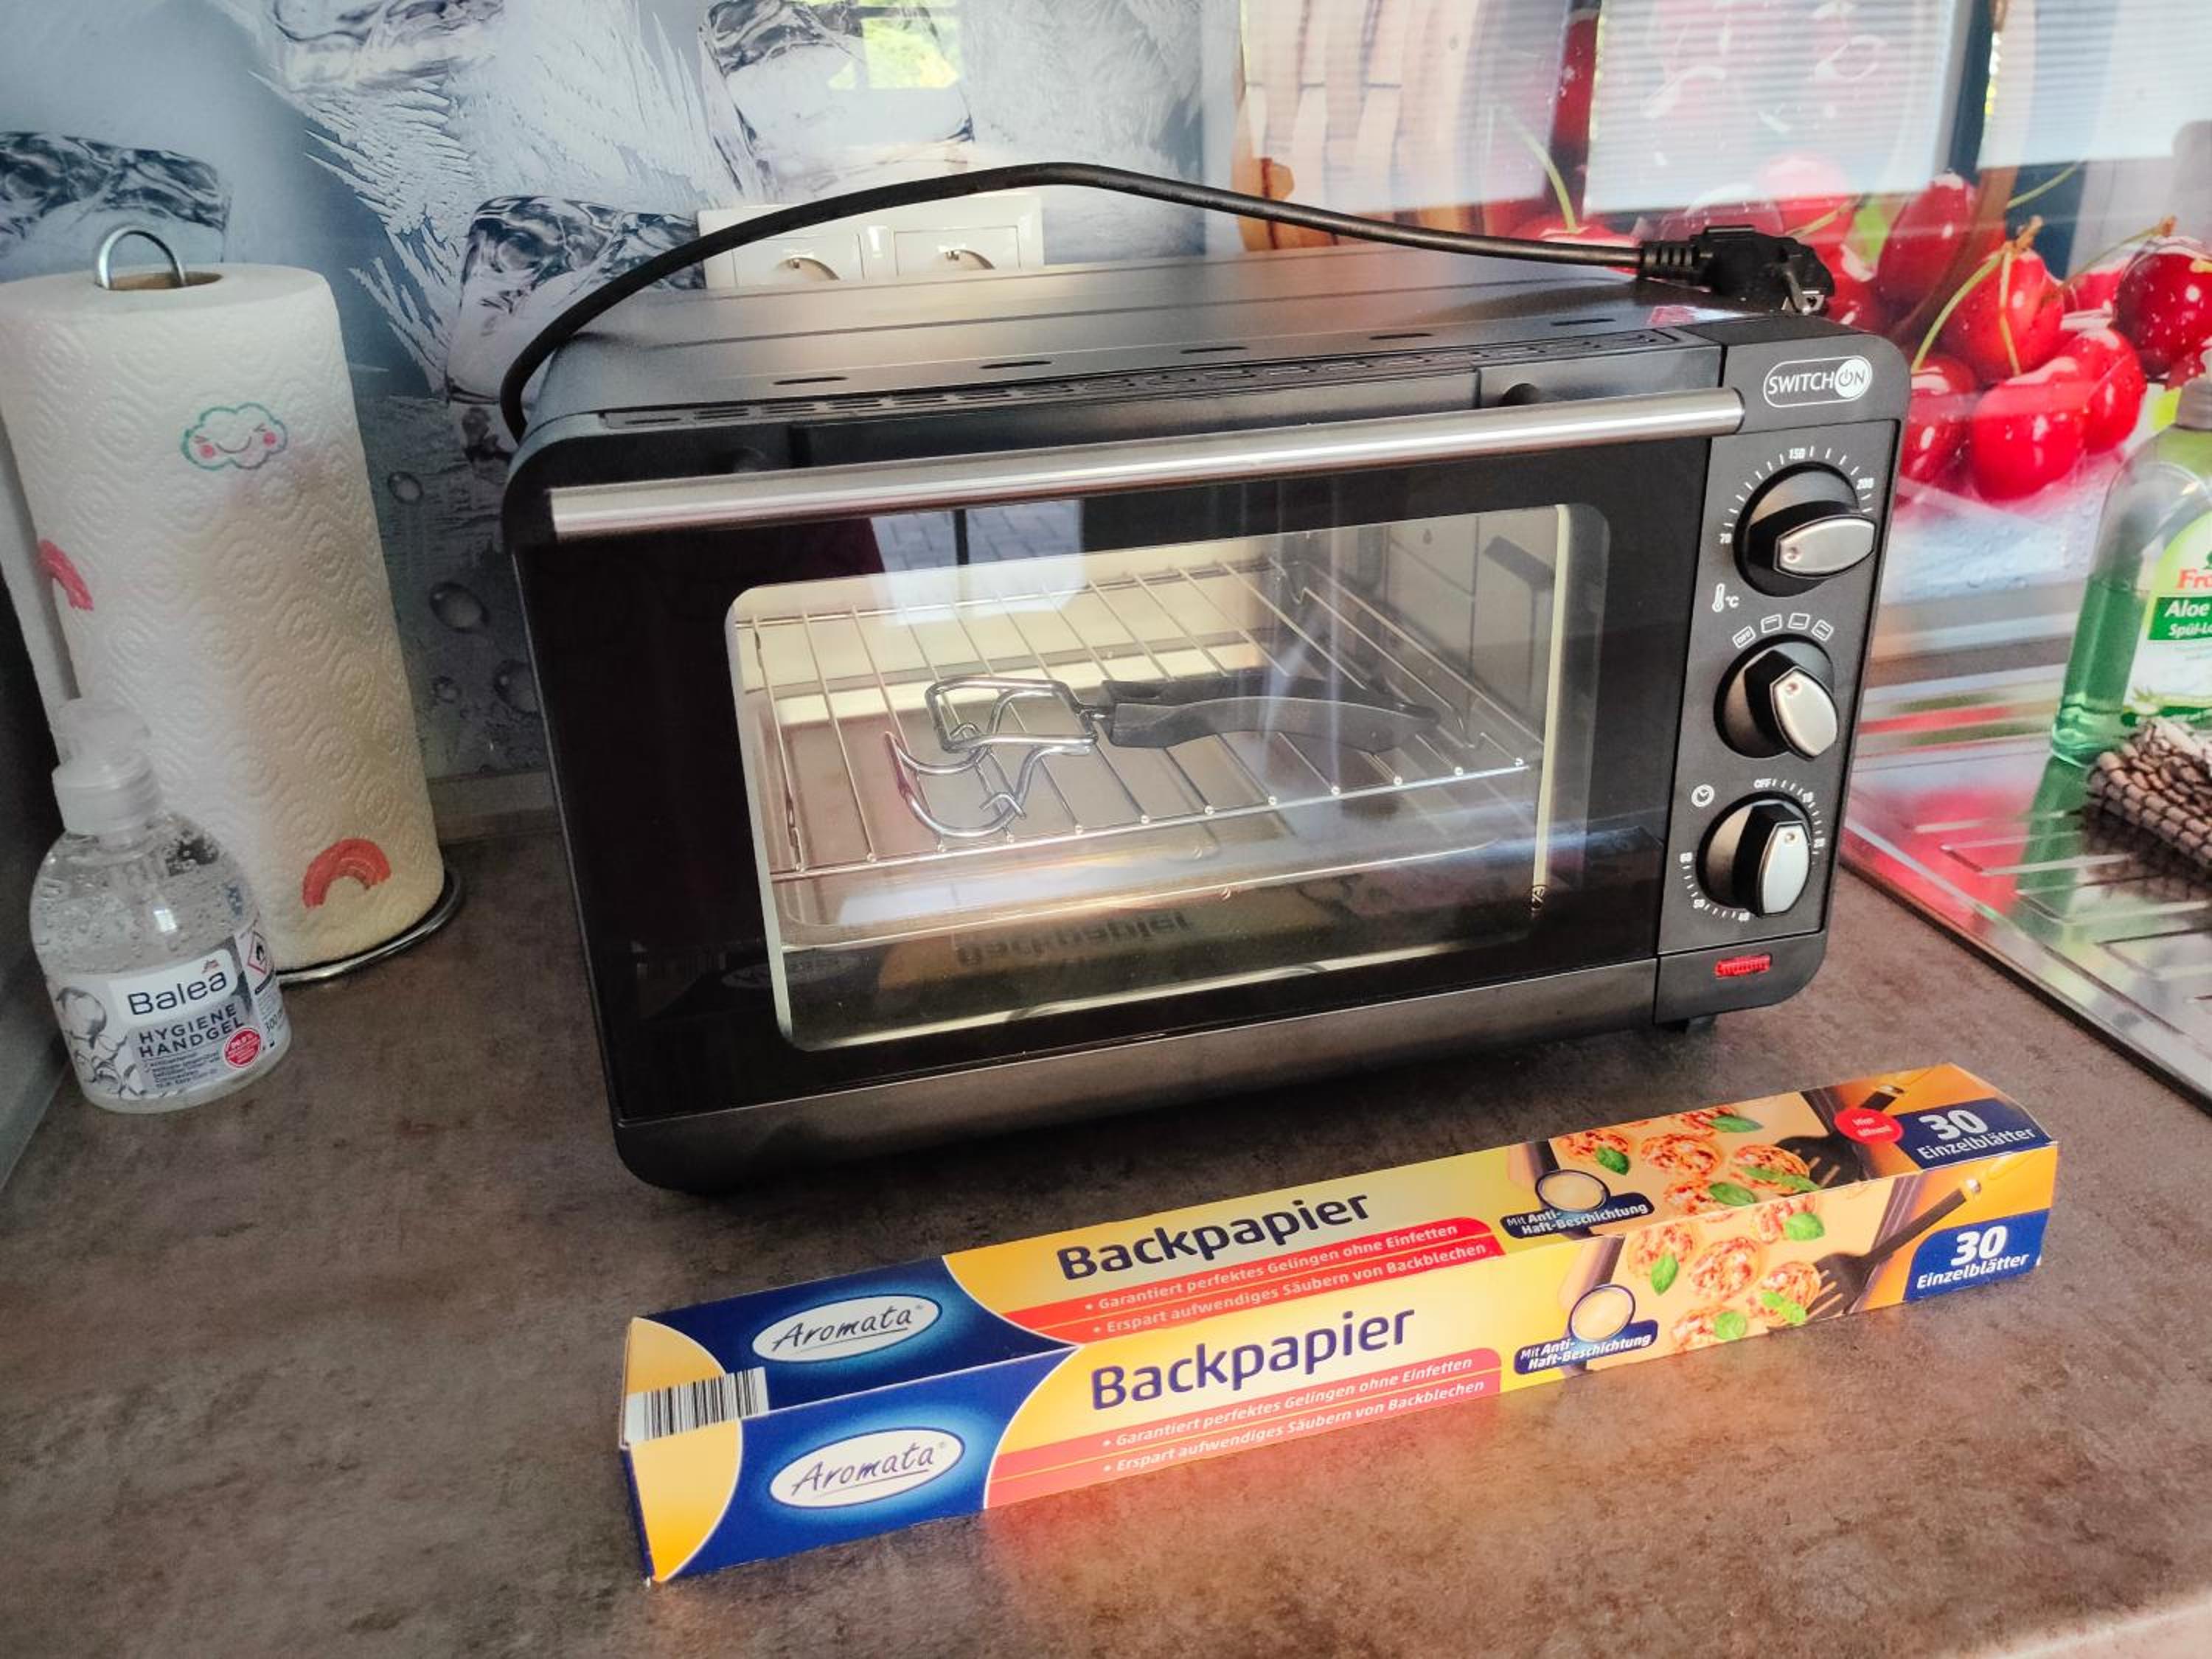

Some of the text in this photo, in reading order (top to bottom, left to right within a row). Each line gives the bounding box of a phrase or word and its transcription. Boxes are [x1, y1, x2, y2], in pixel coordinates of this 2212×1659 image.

[2165, 599, 2211, 618] Aloe
[128, 971, 227, 1015] Balea
[139, 1003, 237, 1044] HYGIENE
[139, 1017, 245, 1058] HANDGEL
[1917, 1127, 2037, 1161] Einzelblätter
[1919, 1109, 1989, 1141] 30
[1057, 1194, 1369, 1281] Backpapier
[1506, 1210, 1562, 1228] Mit Anti-
[1521, 1203, 1649, 1235] Haft-Beschichtung
[1950, 1225, 2008, 1267] 30
[1098, 1224, 1458, 1310] Garantiert perfektes Gelingen ohne Einfetten
[1106, 1242, 1487, 1333] Erspart aufwendiges Säubern von Backblechen
[1916, 1253, 2030, 1290] Einzelblätter
[772, 1304, 912, 1353] Aromata
[1520, 1338, 1576, 1360] Mit Anti-
[1091, 1308, 1415, 1411] Backpapier
[1527, 1333, 1652, 1371] Haft-Beschichtung
[1115, 1357, 1473, 1447] Garantiert perfektes Gelingen ohne Einfetten
[1116, 1379, 1485, 1472] Erspart aufwendiges Säubern von Backblechen
[790, 1444, 934, 1497] Aromata
